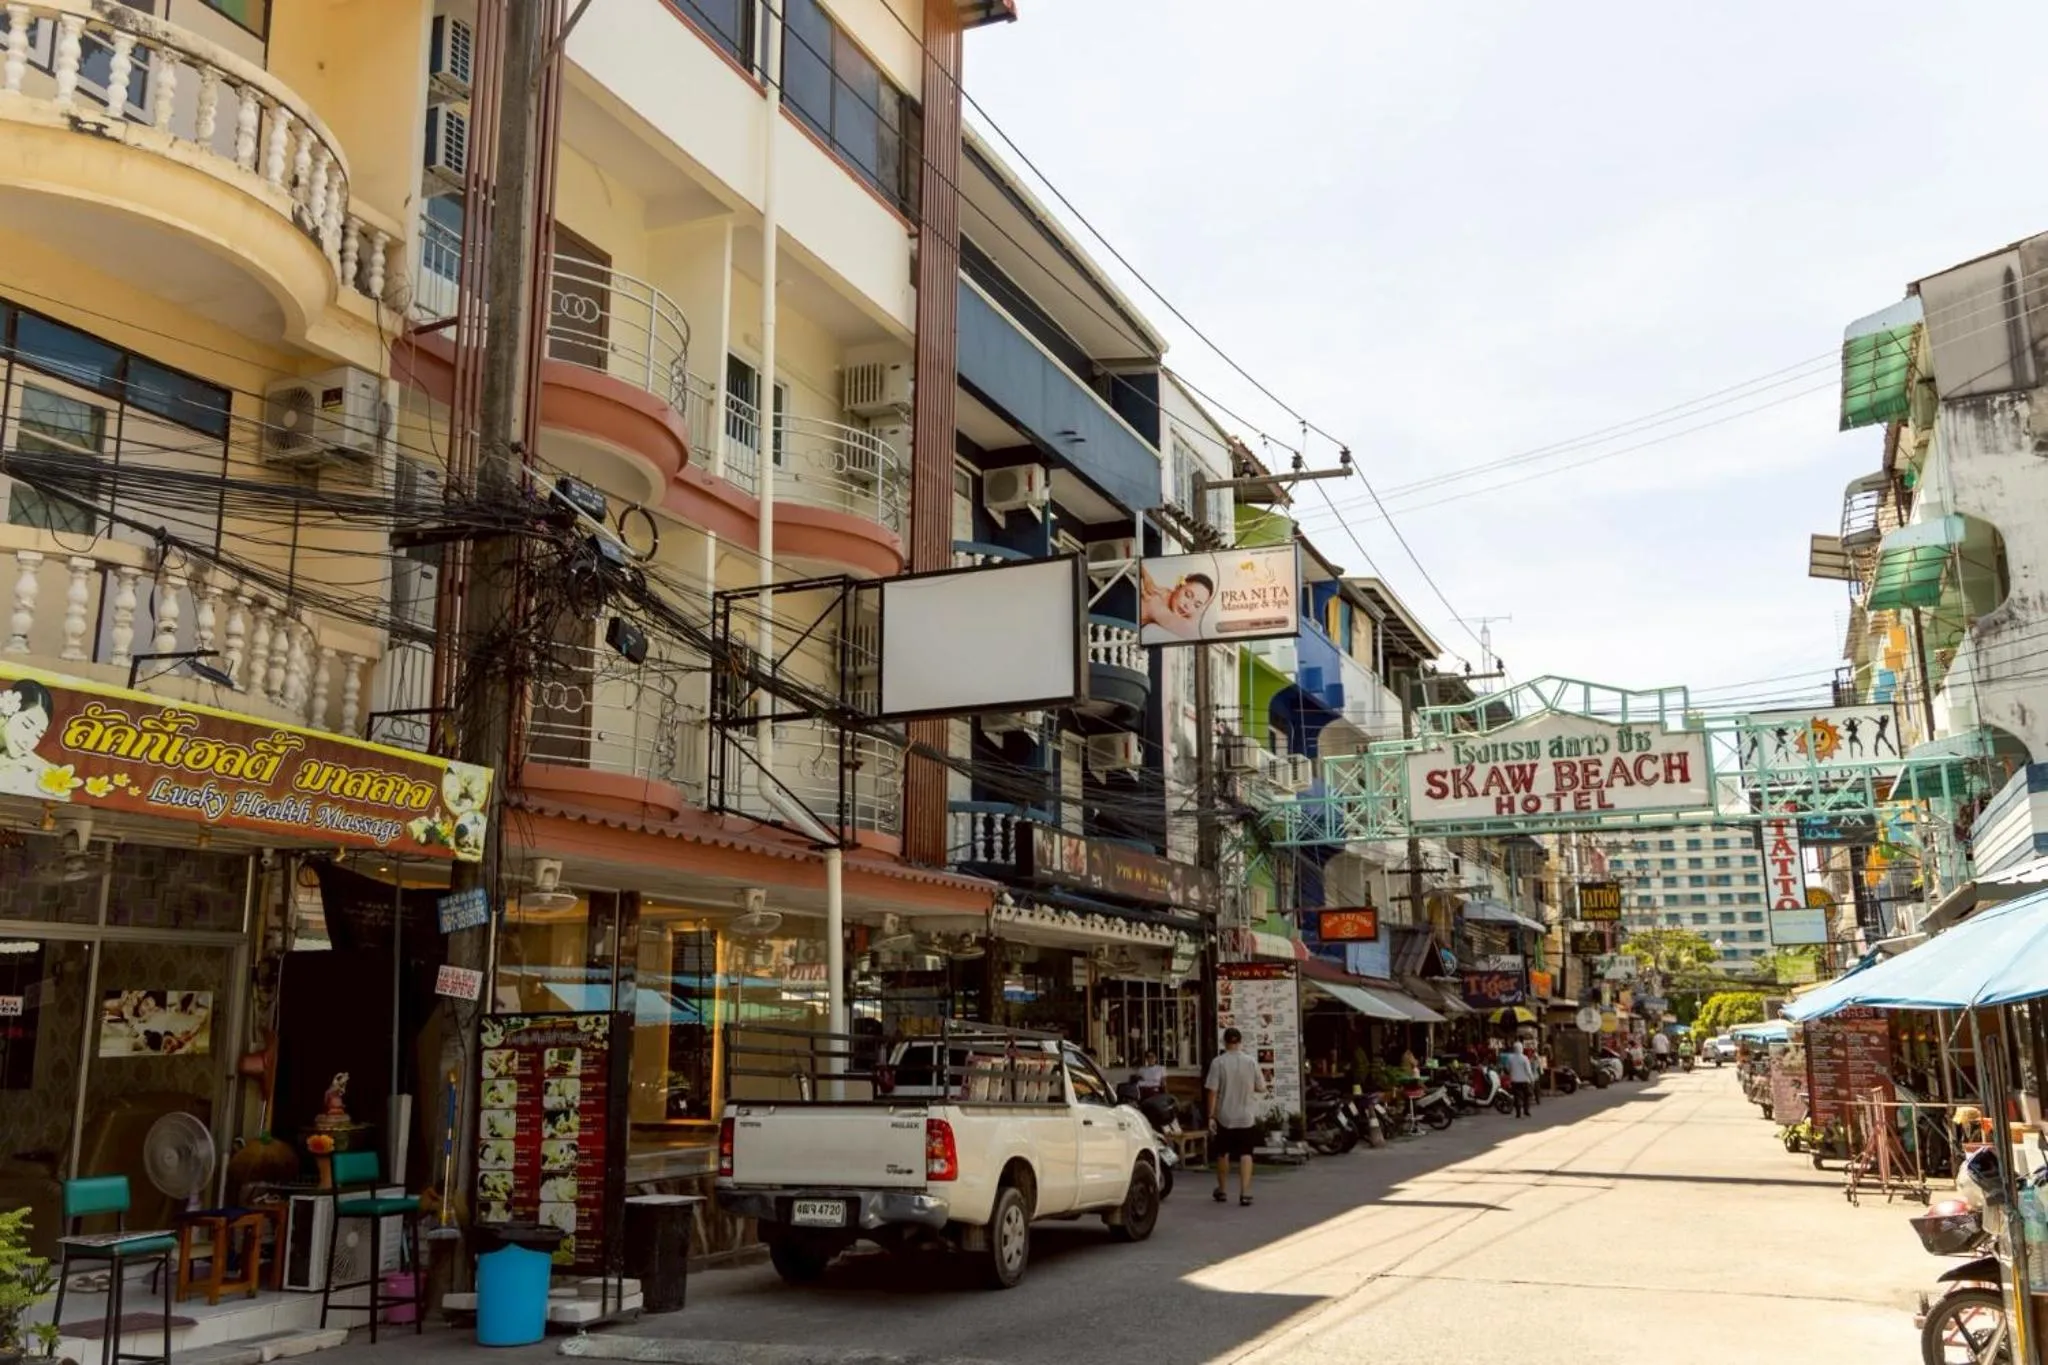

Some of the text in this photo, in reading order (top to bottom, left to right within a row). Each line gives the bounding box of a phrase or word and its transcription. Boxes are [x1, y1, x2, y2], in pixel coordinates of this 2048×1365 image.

[1453, 741, 1540, 766] โรงแรม
[1425, 752, 1691, 799] SKAW BEACH
[147, 778, 402, 848] Lucky Health Massage
[1495, 790, 1615, 815] HOTEL
[1581, 889, 1619, 908] TATTOO
[1464, 975, 1519, 1001] Tiger
[818, 1205, 841, 1215] 4720
